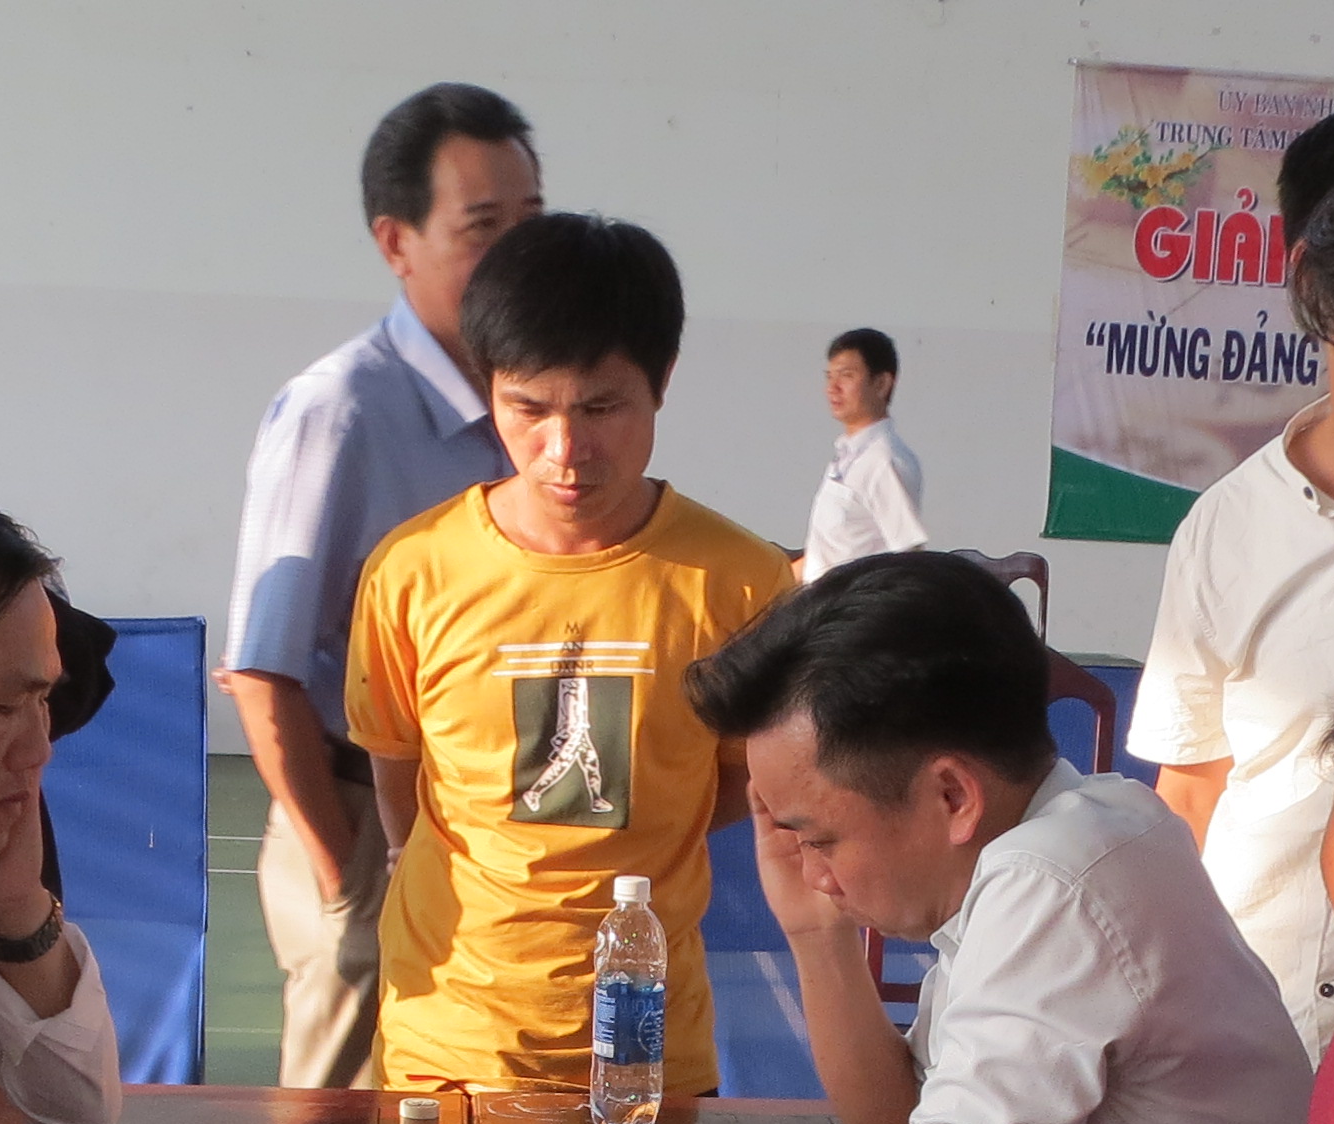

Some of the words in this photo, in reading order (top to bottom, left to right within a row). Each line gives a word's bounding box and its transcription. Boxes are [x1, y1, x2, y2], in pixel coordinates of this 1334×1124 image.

[1254, 94, 1297, 116] BAN
[1156, 121, 1233, 147] TRUNG
[1222, 310, 1320, 387] ĐẢNG
